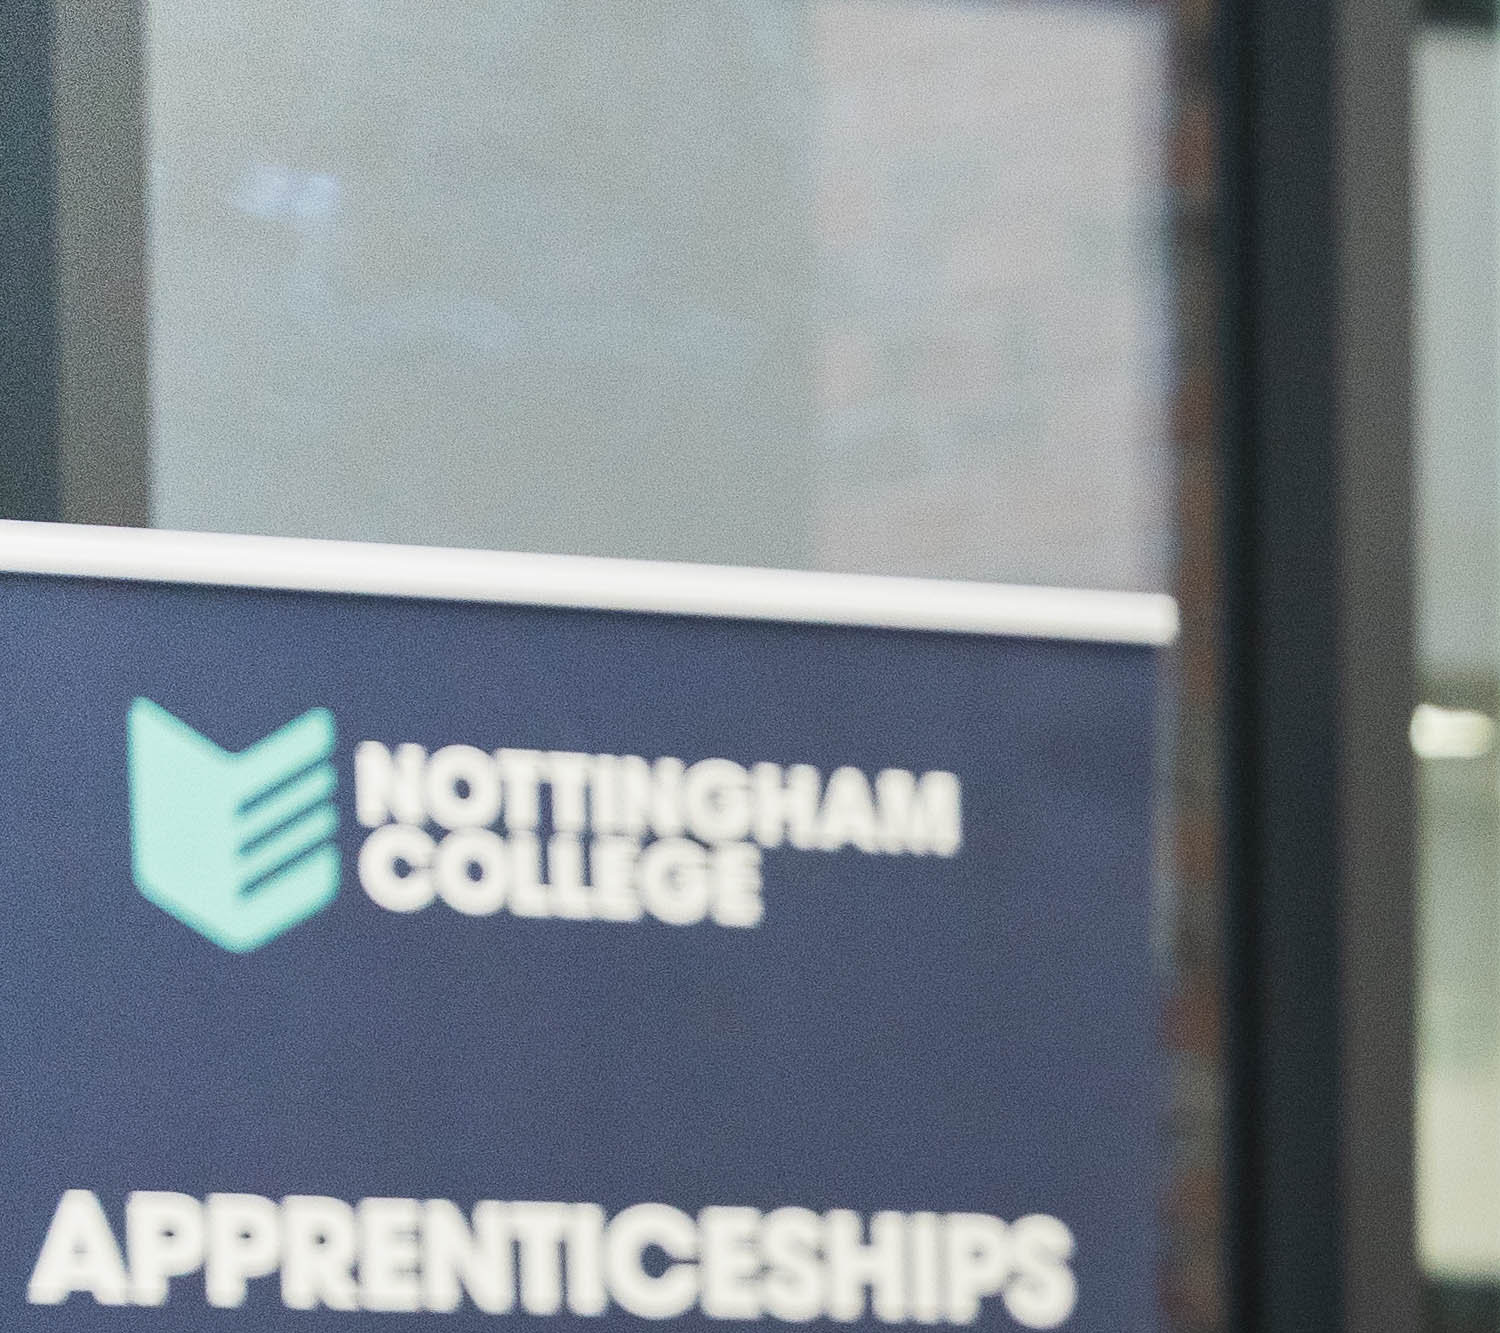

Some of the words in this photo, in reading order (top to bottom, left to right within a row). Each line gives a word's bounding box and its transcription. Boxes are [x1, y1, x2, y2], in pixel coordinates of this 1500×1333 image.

[354, 740, 963, 857] NOTTINGHAM
[357, 824, 764, 928] COLLEGE
[27, 1188, 1077, 1329] APPRENTICESHIPS
